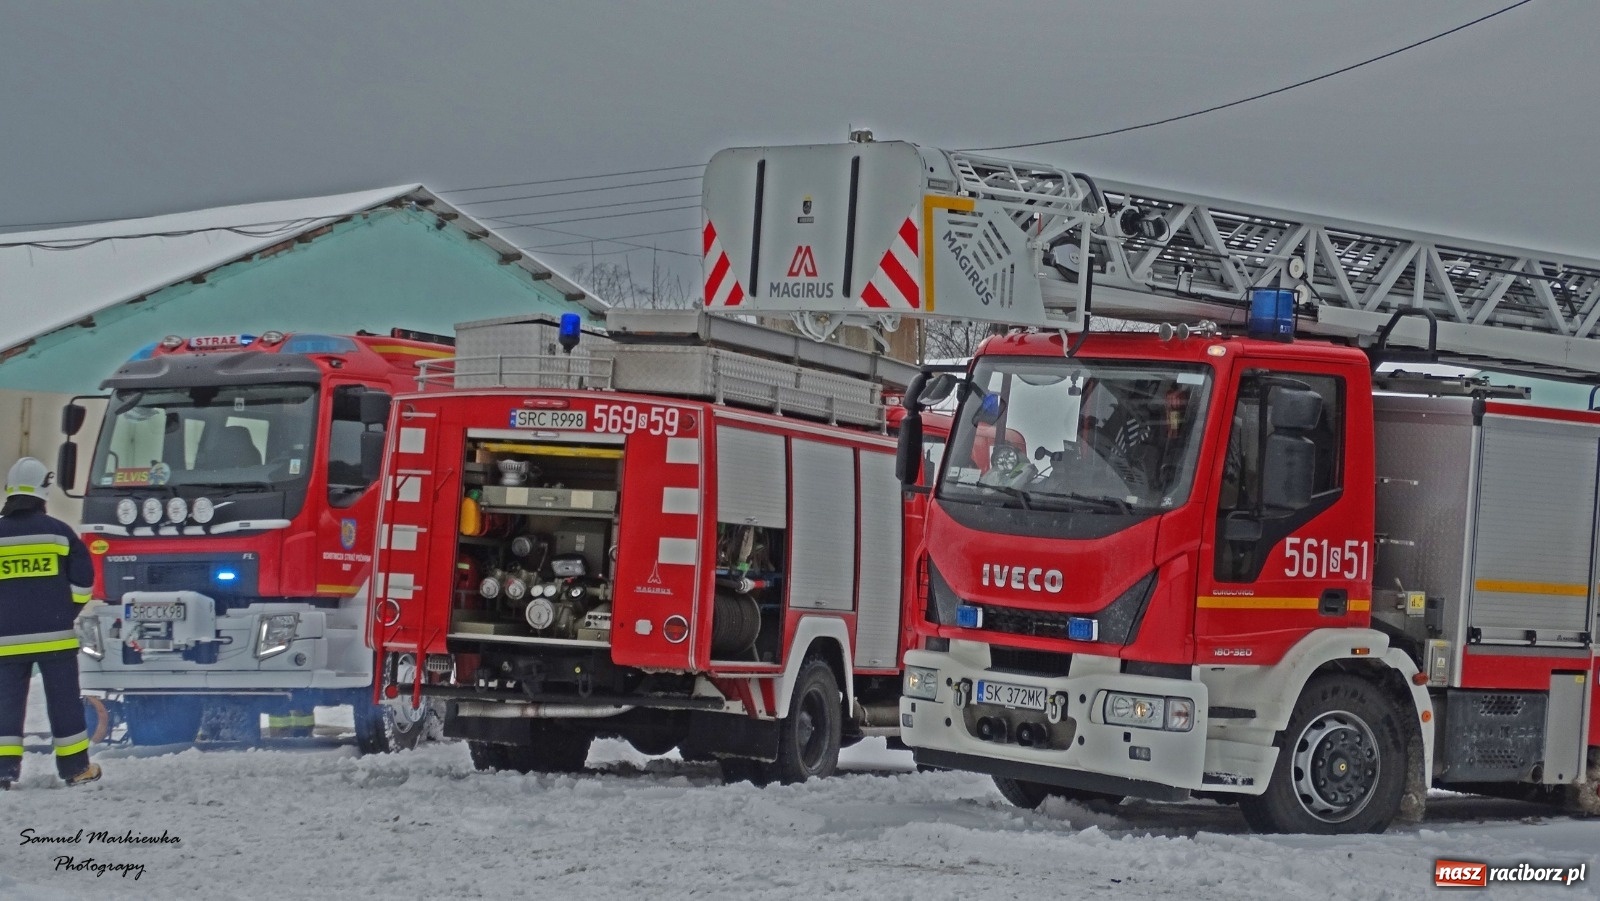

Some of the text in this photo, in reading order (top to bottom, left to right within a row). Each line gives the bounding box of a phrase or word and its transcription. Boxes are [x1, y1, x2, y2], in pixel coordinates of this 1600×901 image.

[943, 230, 994, 307] MAGIRUS
[769, 281, 834, 299] MAGIRUS
[518, 411, 584, 428] SRC R998
[115, 471, 149, 483] ELVIS
[981, 563, 1064, 593] IVECO
[132, 605, 183, 619] SRC CK98
[985, 684, 1043, 708] SK 372MK
